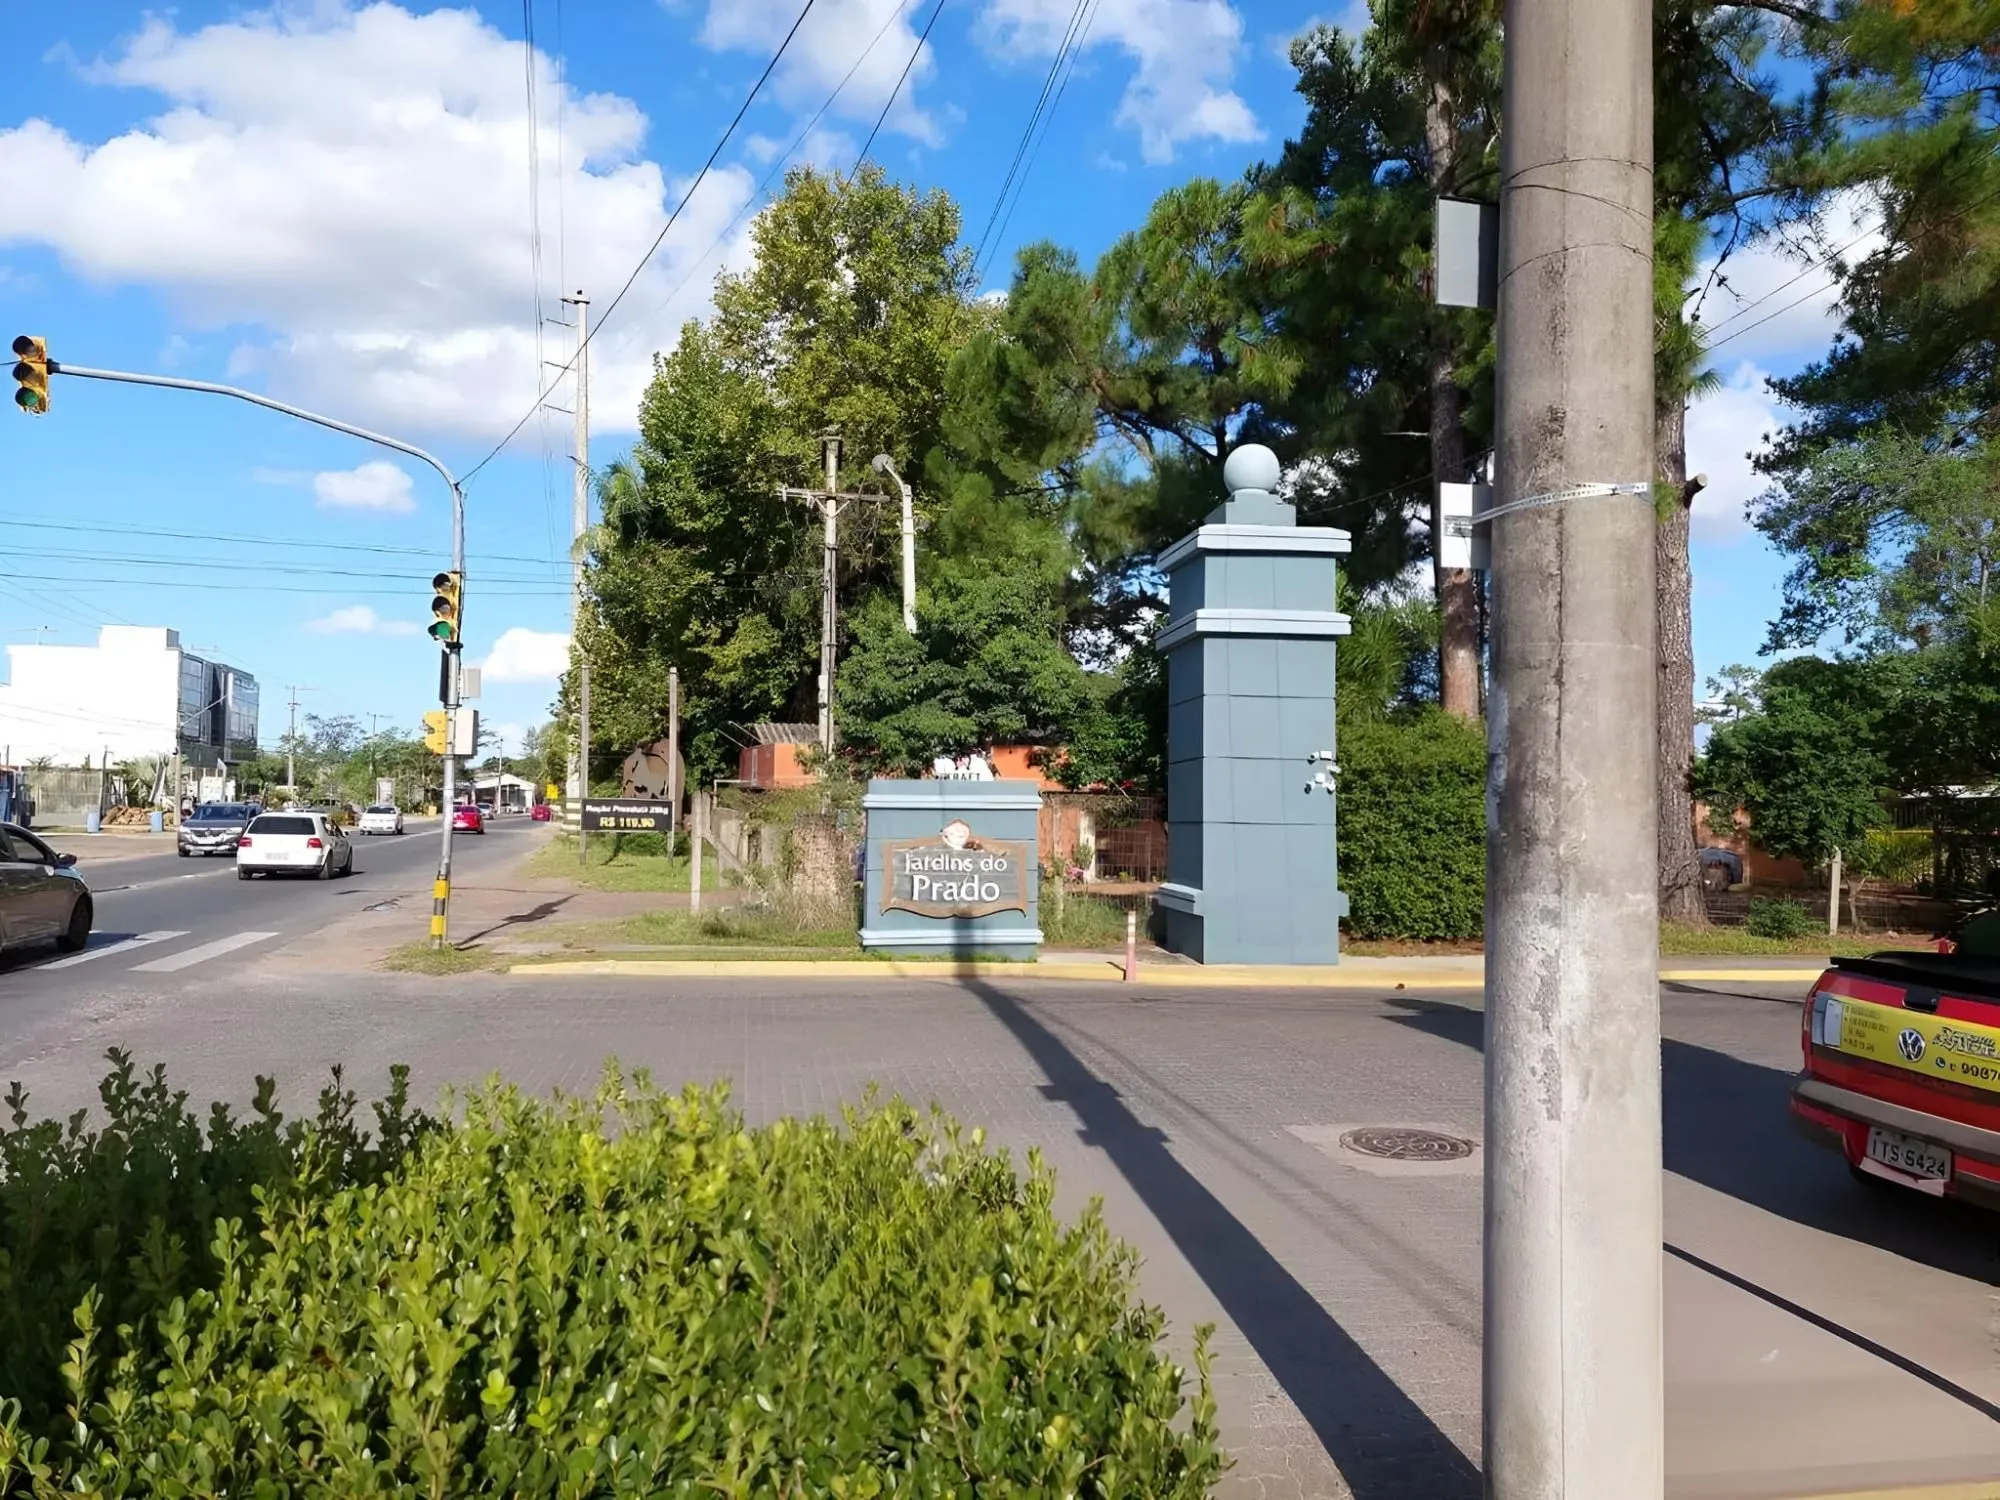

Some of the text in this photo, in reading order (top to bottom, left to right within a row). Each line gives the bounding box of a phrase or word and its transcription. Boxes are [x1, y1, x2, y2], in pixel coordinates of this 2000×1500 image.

[905, 853, 1008, 874] Jardins do
[912, 874, 1000, 901] Prado
